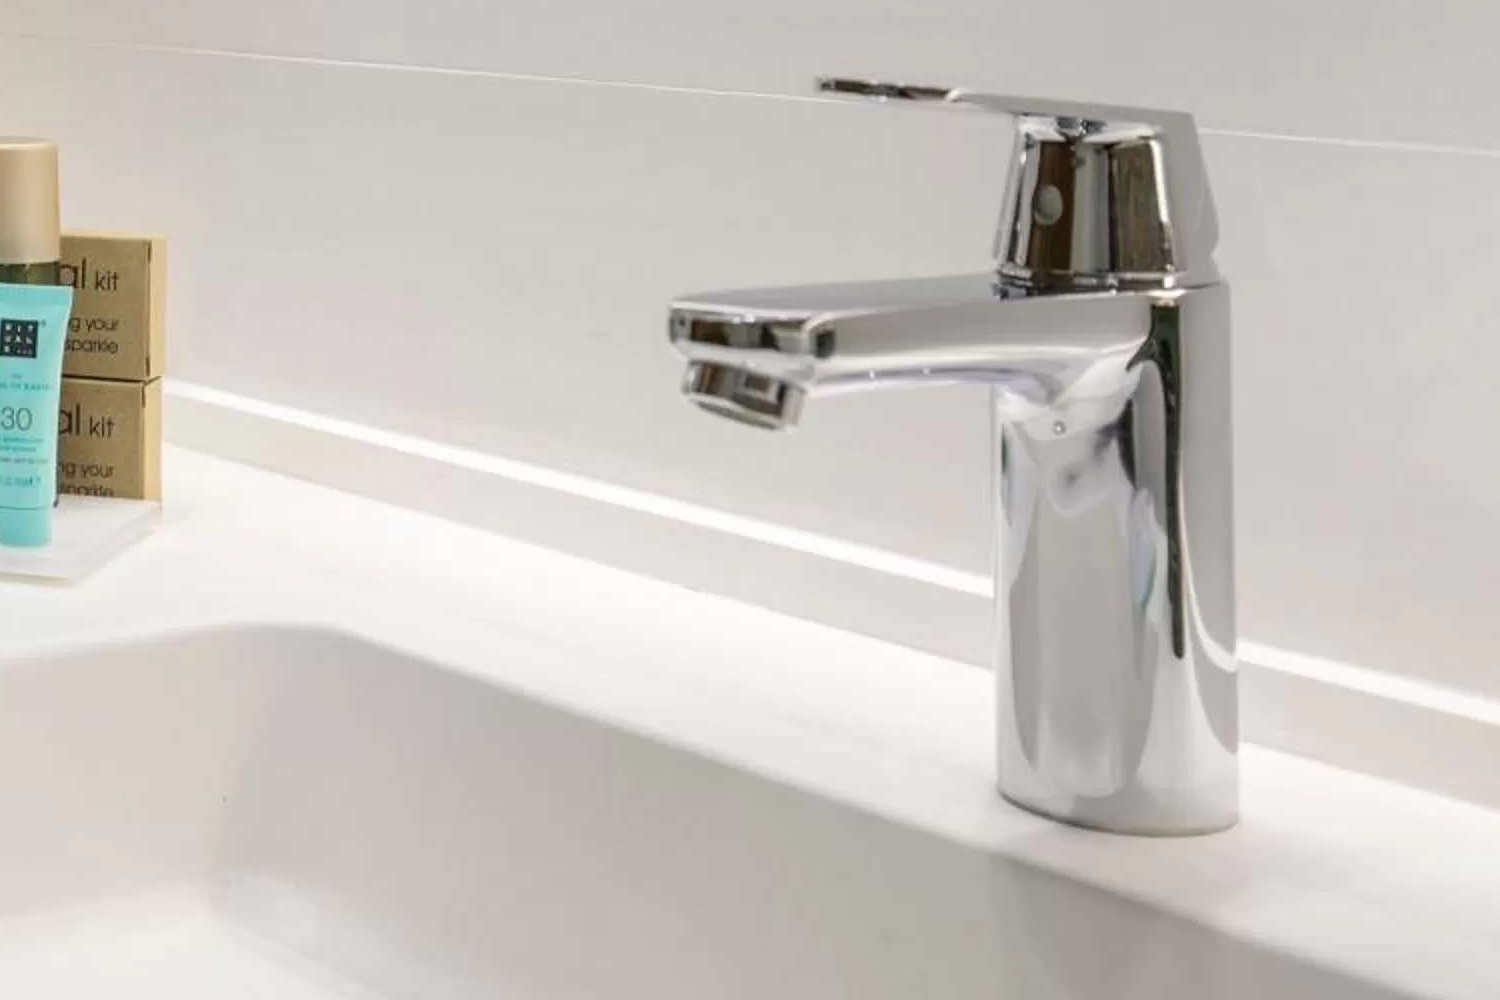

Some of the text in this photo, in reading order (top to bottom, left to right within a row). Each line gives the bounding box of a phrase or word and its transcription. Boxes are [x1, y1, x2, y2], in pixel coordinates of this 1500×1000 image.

[96, 270, 120, 292] kit
[85, 318, 120, 334] your
[1, 405, 32, 431] 30
[89, 414, 114, 437] kit
[80, 463, 115, 479] your
